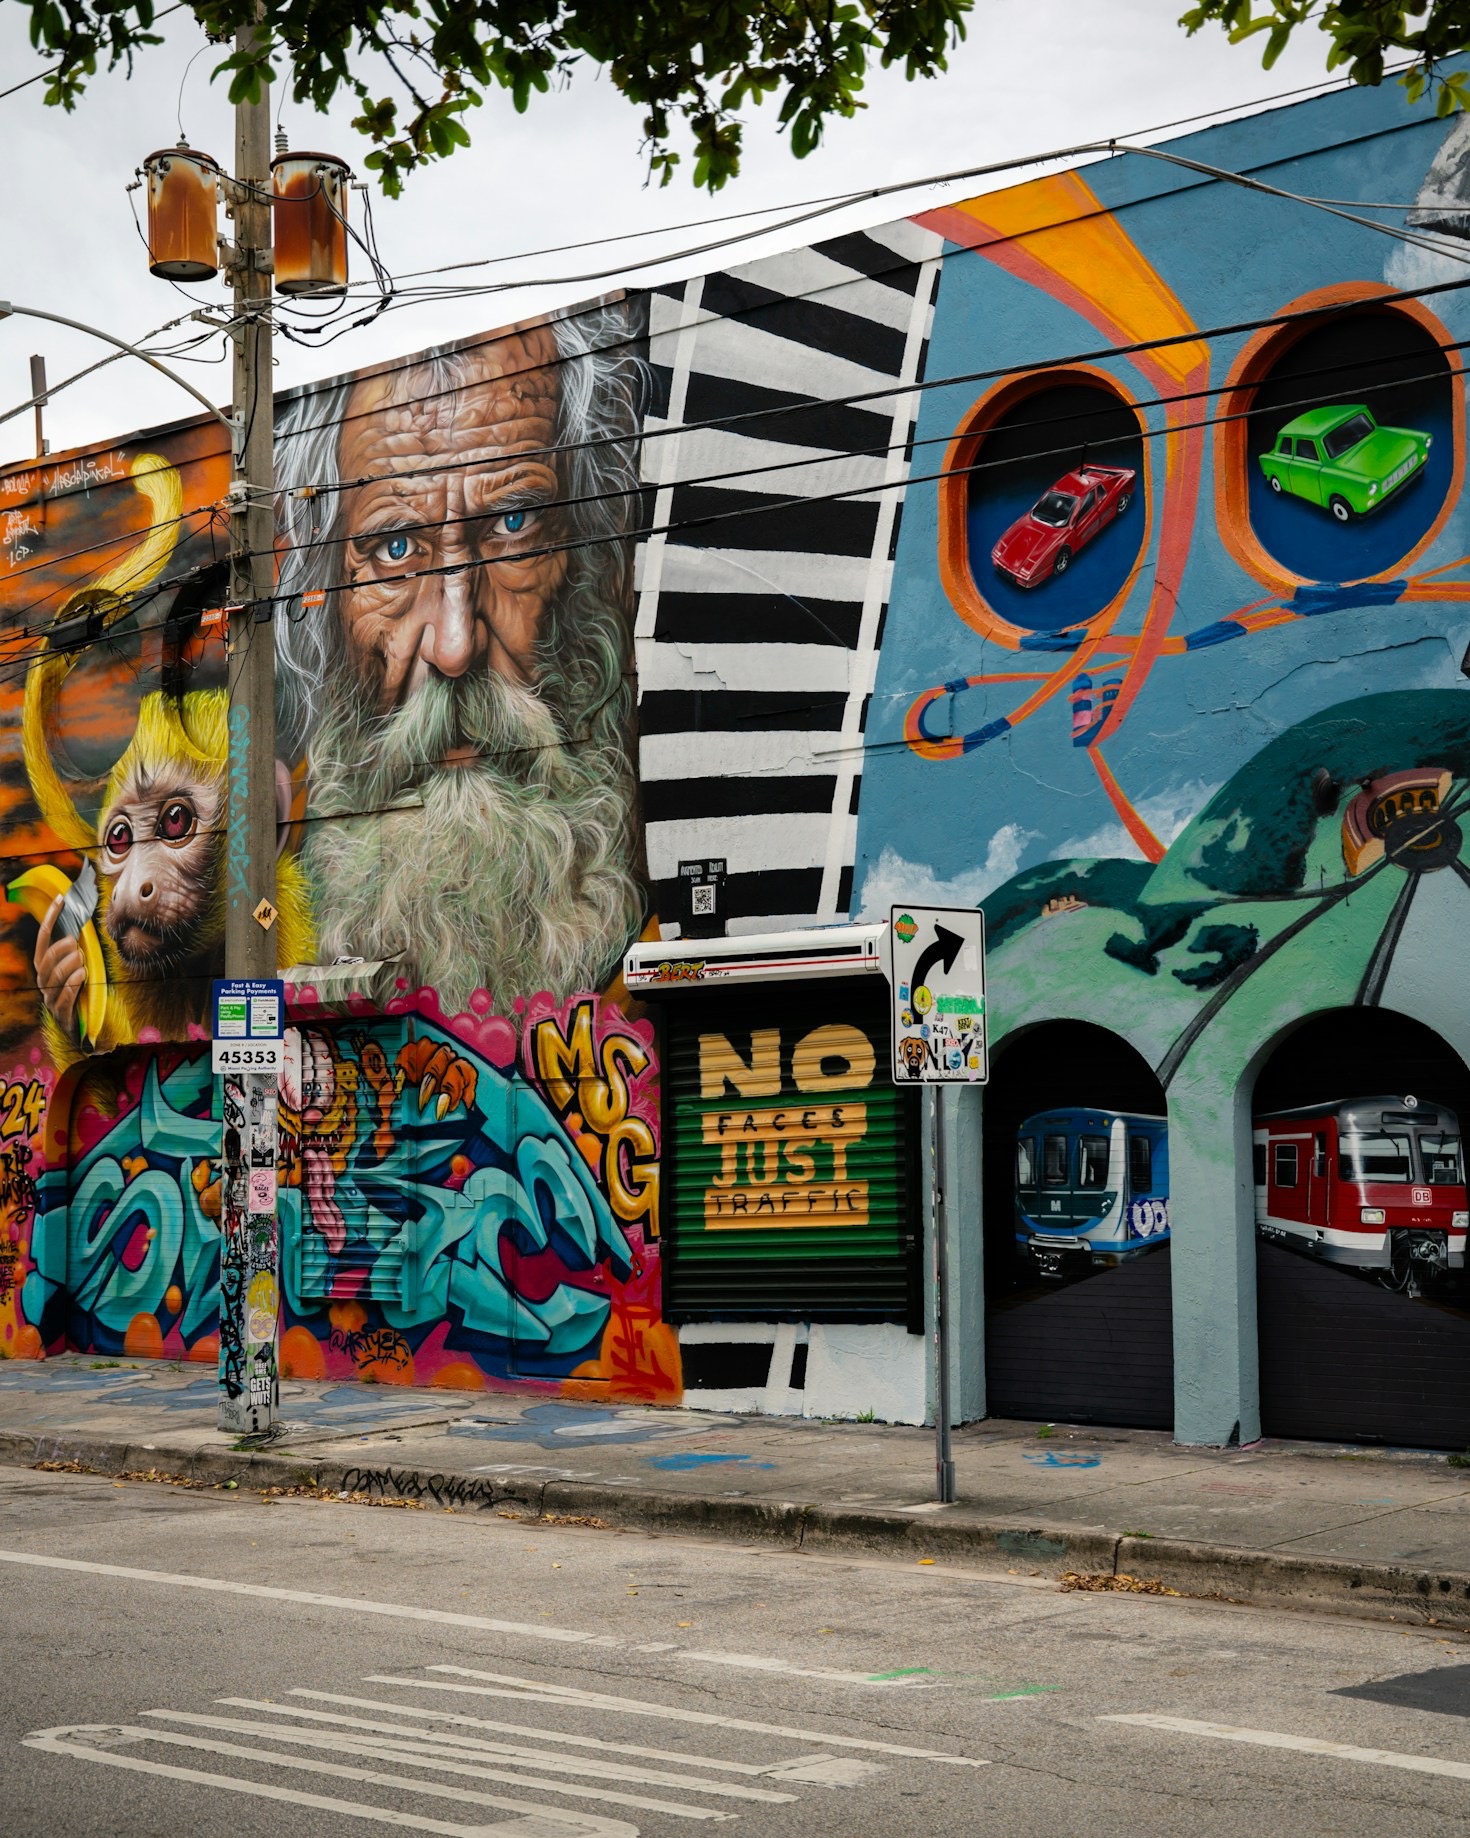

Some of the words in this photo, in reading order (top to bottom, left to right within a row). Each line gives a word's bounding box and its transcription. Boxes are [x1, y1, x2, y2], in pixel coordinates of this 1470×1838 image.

[932, 1024, 949, 1036] K47
[219, 1050, 277, 1064] 45353
[698, 1023, 877, 1098] NO
[717, 1108, 846, 1135] FACES
[712, 1136, 862, 1188] JUST
[710, 1189, 862, 1216] TRAFFIC
[250, 1376, 271, 1392] GETS
